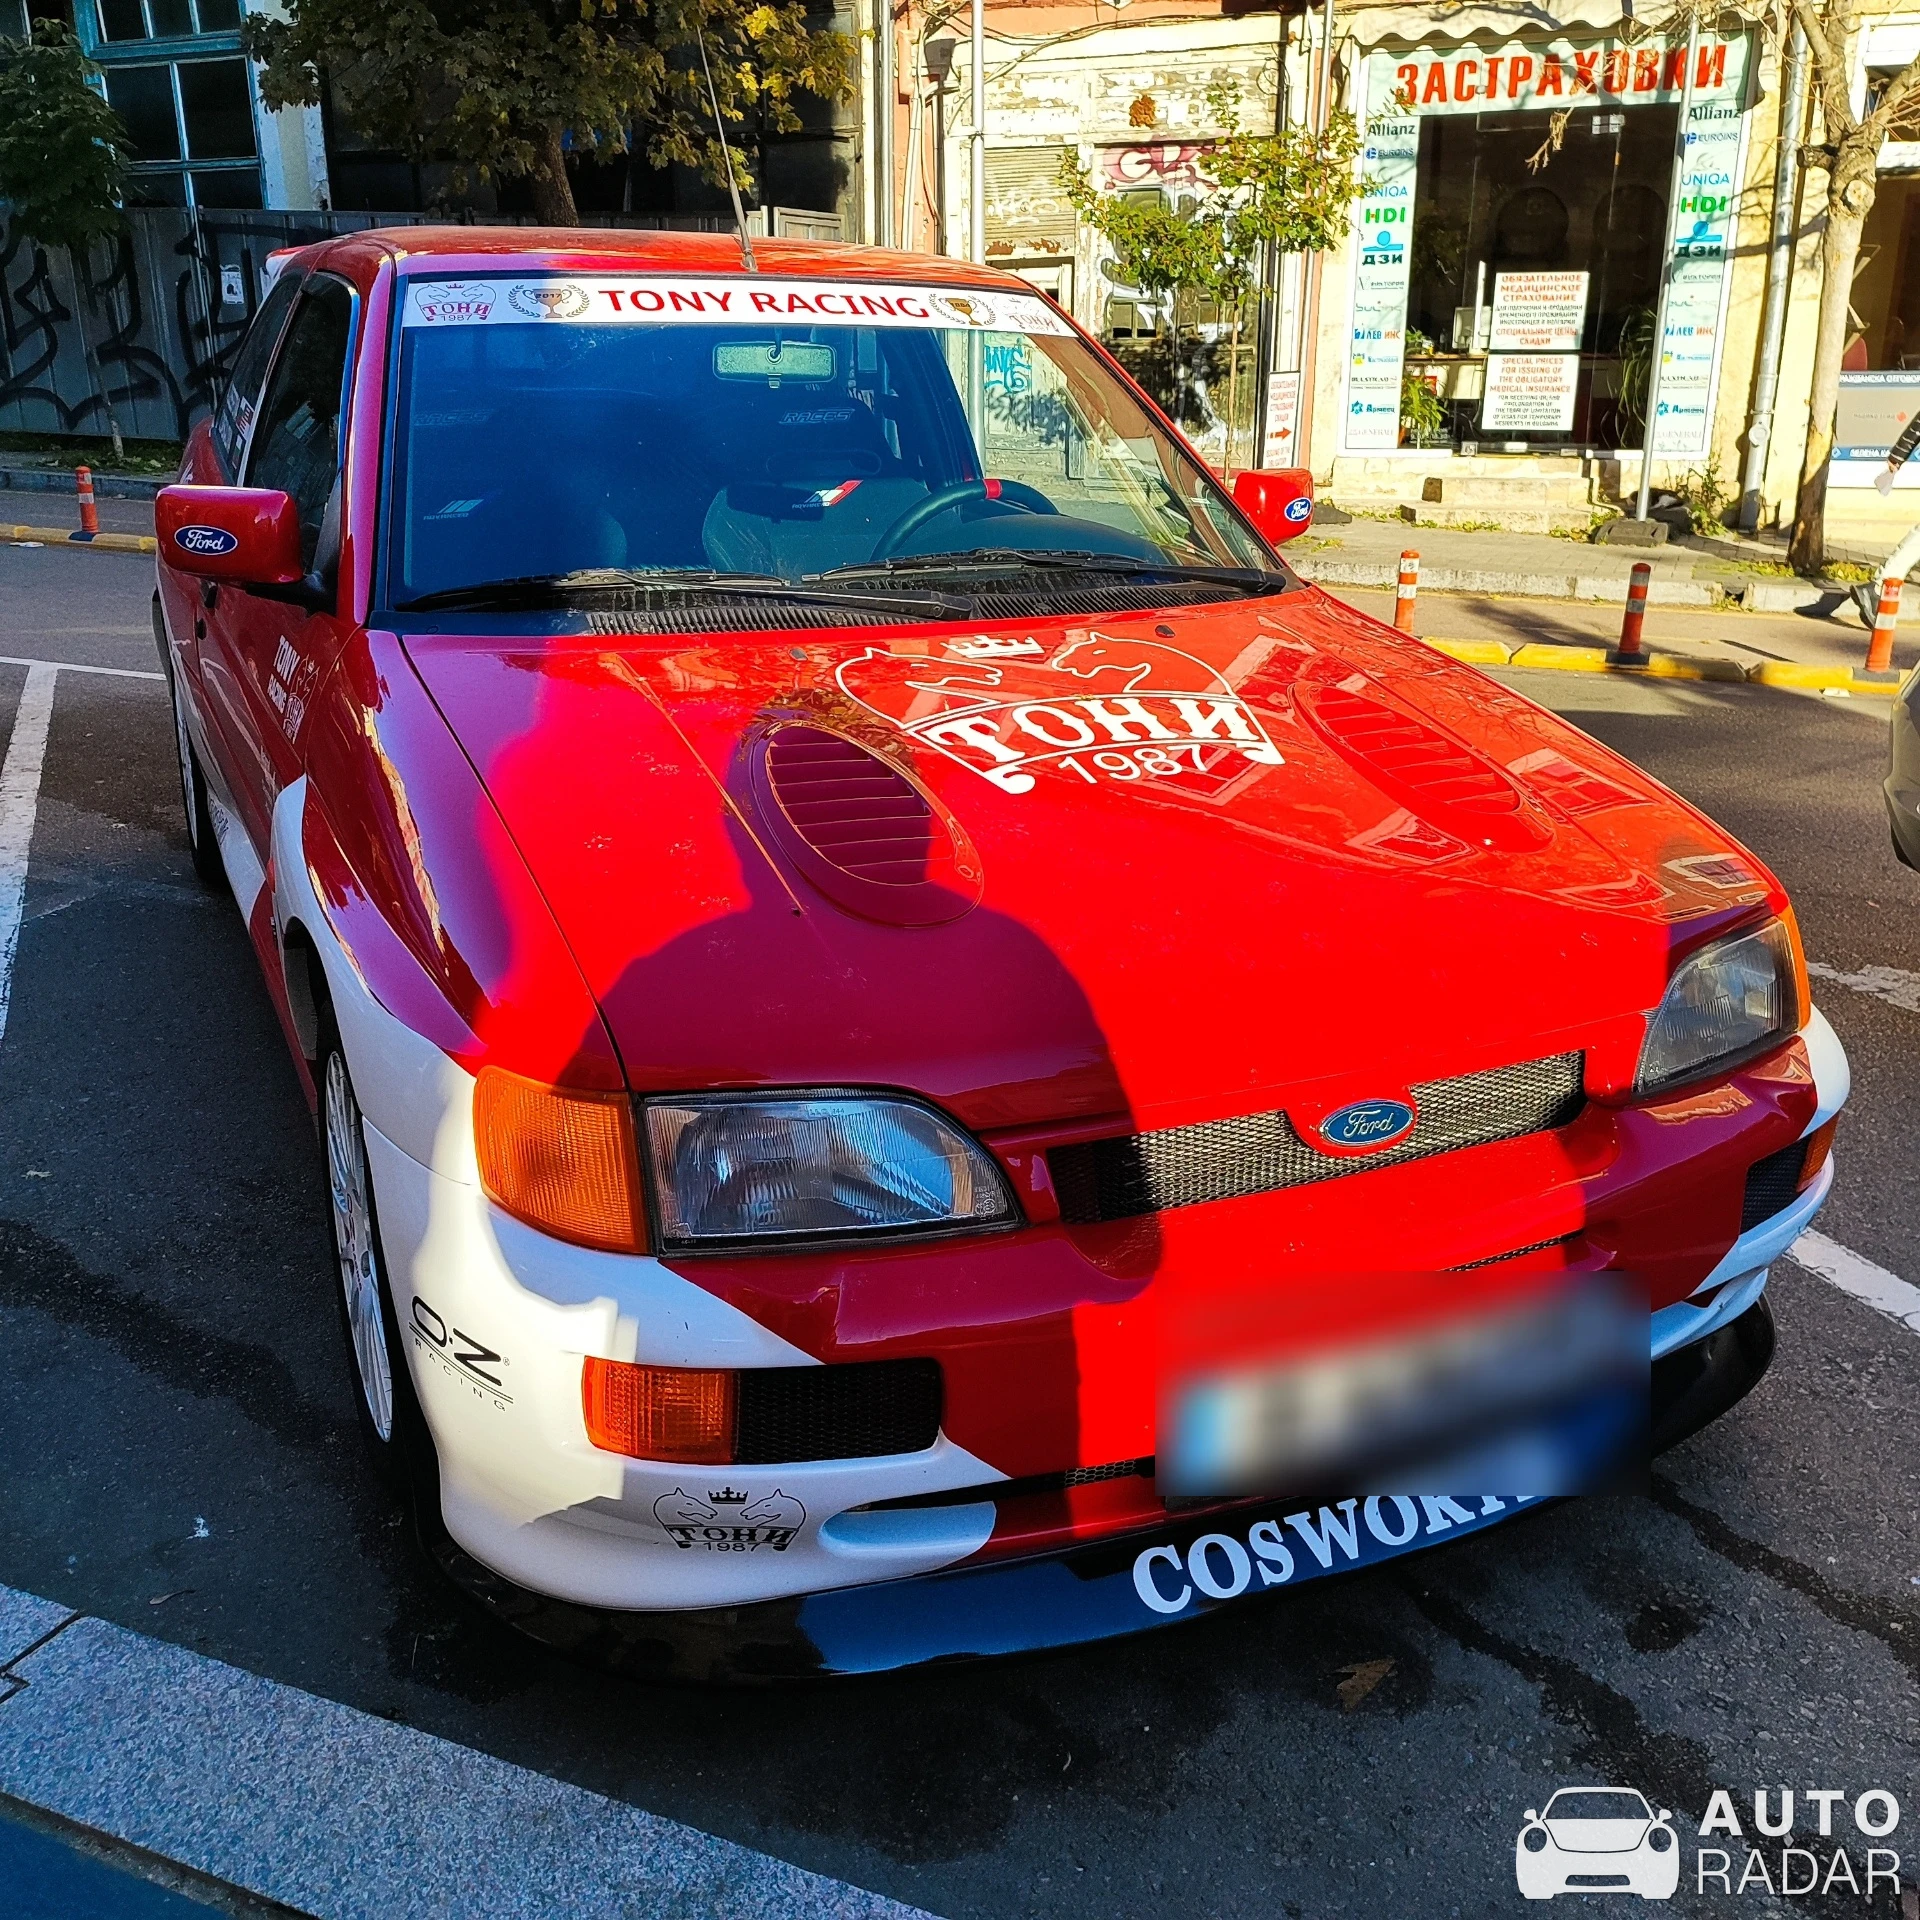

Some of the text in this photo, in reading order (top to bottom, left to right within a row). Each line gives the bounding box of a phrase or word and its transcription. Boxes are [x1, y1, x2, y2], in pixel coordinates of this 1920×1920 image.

[1397, 45, 1727, 106] ЗАСТРАХОВКИ
[1688, 106, 1742, 119] Allianz
[1367, 123, 1416, 137] Allianz
[1698, 132, 1739, 142] EUROINS
[1378, 147, 1414, 157] EUROINS
[1681, 173, 1730, 186] UNIQA
[1680, 196, 1727, 213] HDI
[1365, 207, 1406, 224] HDI
[1674, 245, 1721, 259] ДЗИ
[1362, 254, 1403, 266] ДЗИ
[1502, 274, 1583, 283] ОБЯЗАТЕЛЬНОЕ
[1500, 284, 1582, 293] МЕДИЦИНСКОЕ
[598, 290, 930, 318] TONY RACING
[1503, 294, 1577, 302] СТРАХОВАНИЕ
[422, 303, 491, 317] ТОНИ
[441, 314, 473, 322] 1987
[1501, 366, 1563, 374] FOR ISSUING OF
[1515, 375, 1563, 383] OBLIGATORY
[1489, 385, 1571, 393] MEDICAL INSURANCE
[185, 529, 225, 551] Ford
[925, 697, 1260, 764] ТОНИ
[1057, 744, 1208, 784] 1987
[1343, 1109, 1394, 1138] Ford
[415, 1337, 505, 1412] RACING
[668, 1527, 795, 1543] ТОНИ
[703, 1542, 760, 1552] 1987
[1133, 1496, 1537, 1613] COSWOR
